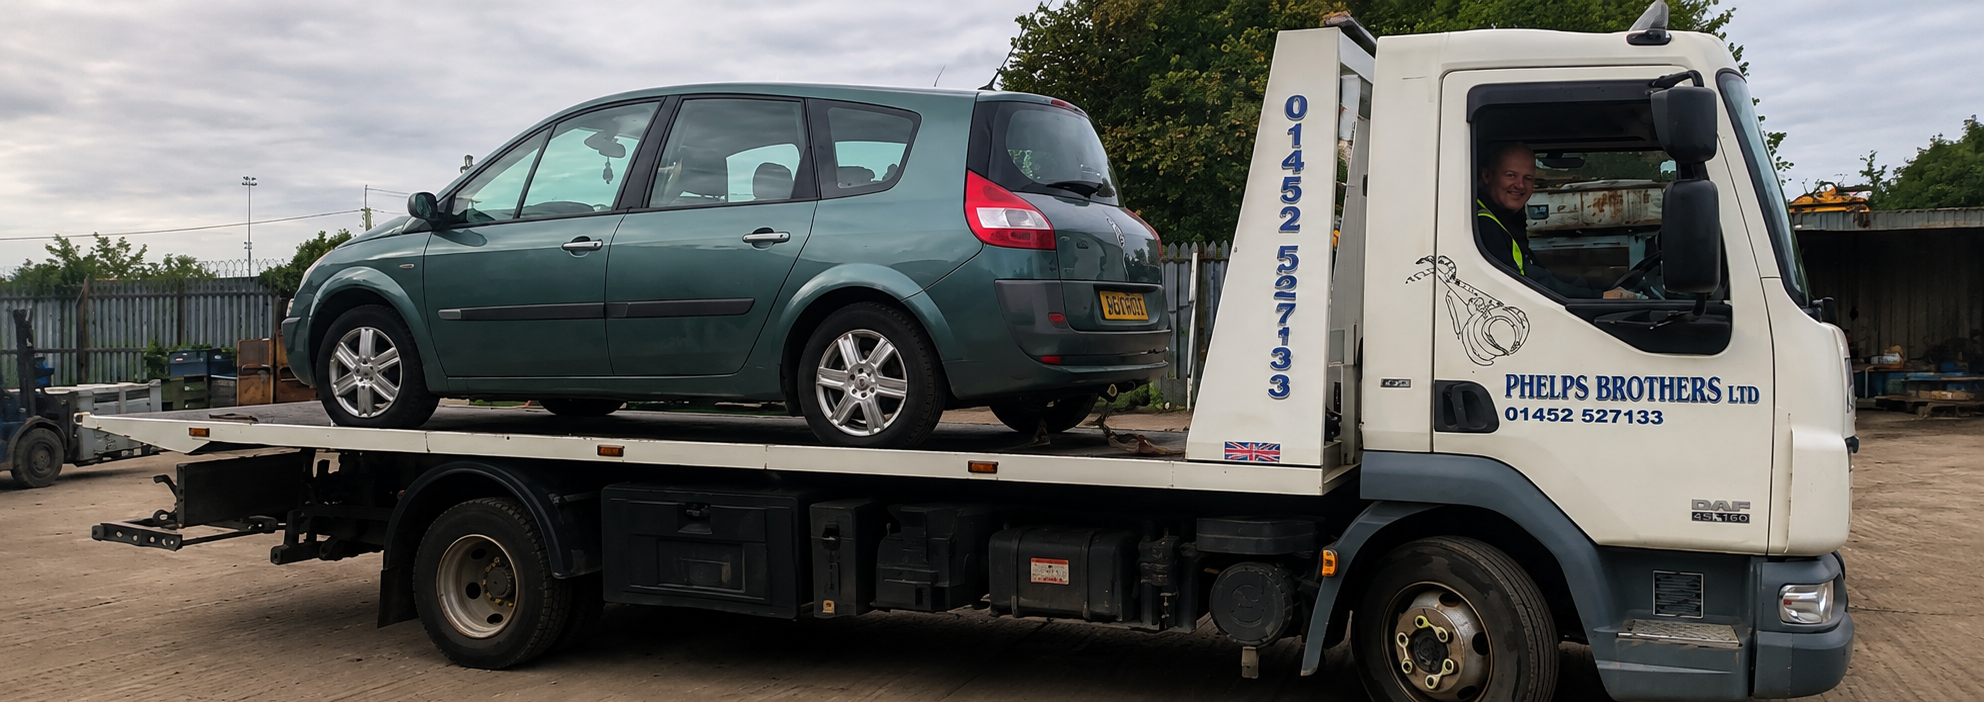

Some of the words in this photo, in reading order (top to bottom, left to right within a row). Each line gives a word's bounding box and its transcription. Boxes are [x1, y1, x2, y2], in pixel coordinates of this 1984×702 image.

[1278, 94, 1308, 233] 01452
[1268, 245, 1299, 399] 527133
[1504, 374, 1589, 401] PHELPS
[1595, 375, 1723, 403] BROTHERS
[1728, 385, 1760, 404] LTD
[1504, 407, 1574, 422] 01452
[1581, 408, 1664, 425] 527133
[1692, 499, 1750, 512] DAF
